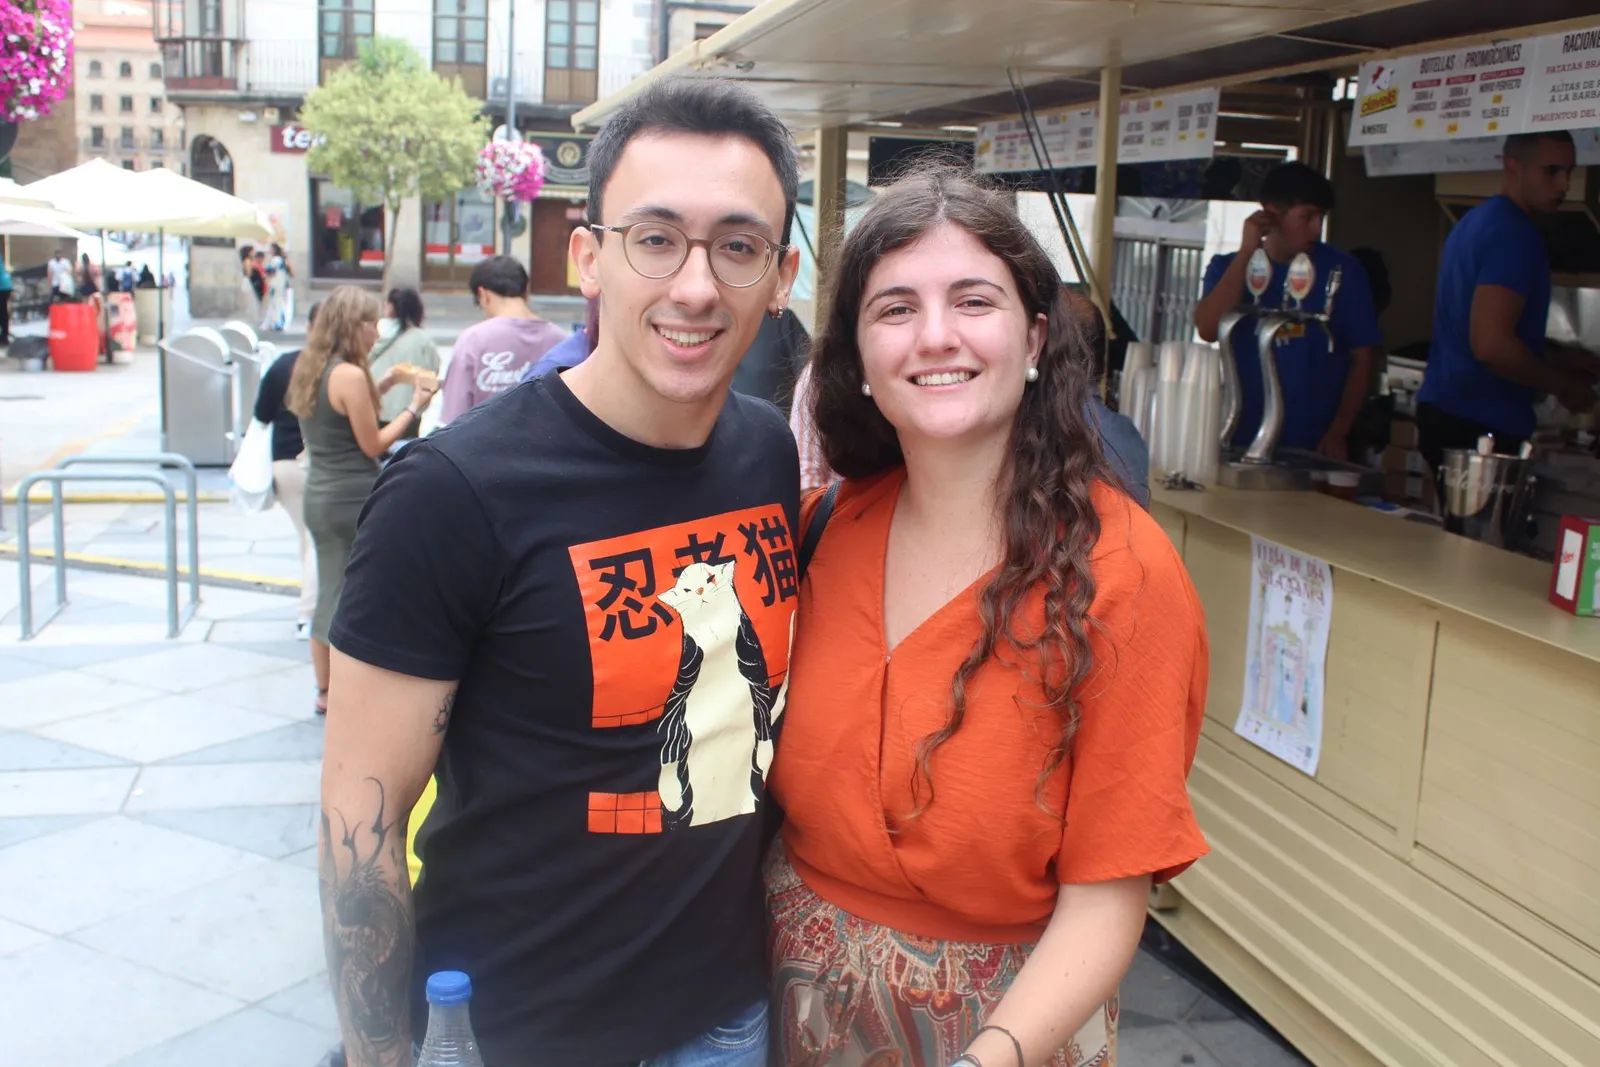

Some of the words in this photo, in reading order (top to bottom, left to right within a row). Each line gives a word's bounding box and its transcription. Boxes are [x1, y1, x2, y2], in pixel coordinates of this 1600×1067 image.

[1420, 54, 1456, 74] BOTELLAS
[1464, 44, 1522, 68] PROMOCIONES
[1583, 80, 1595, 89] DE
